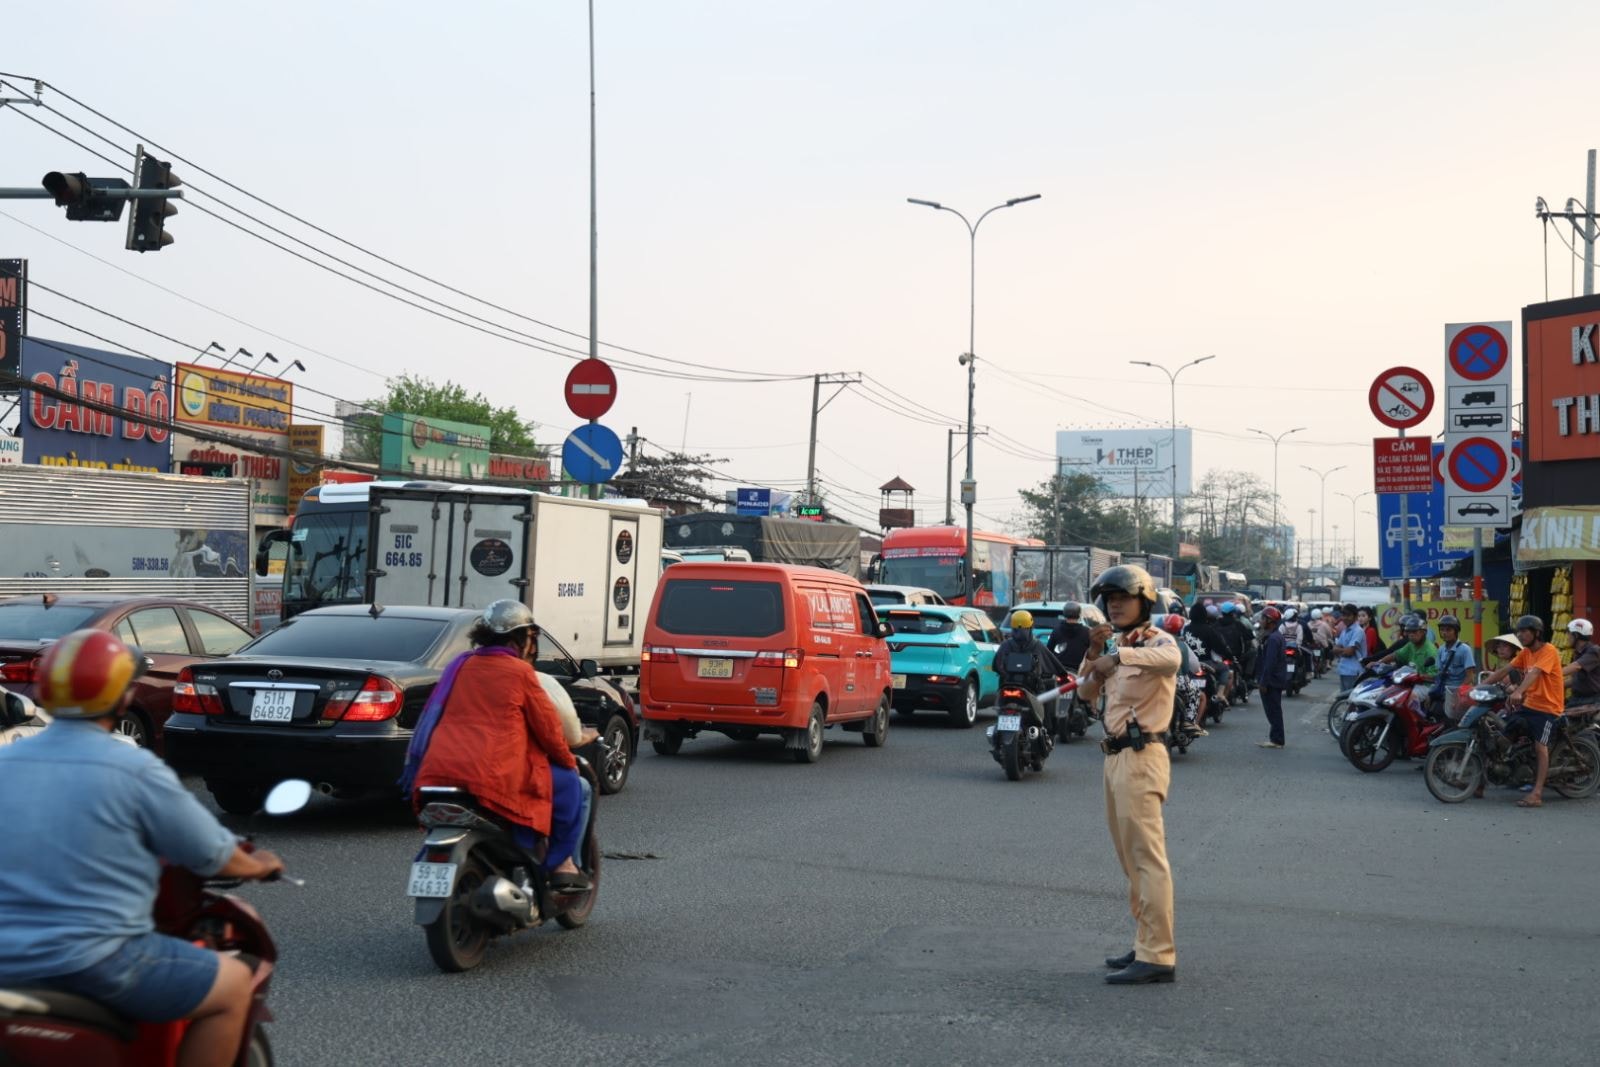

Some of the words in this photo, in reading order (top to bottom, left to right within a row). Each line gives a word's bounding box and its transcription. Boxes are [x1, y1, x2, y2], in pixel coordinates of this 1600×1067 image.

[1572, 322, 1600, 365] K
[1117, 446, 1153, 458] THÉP
[1391, 439, 1416, 452] CẤM
[394, 534, 412, 549] 51C
[386, 552, 422, 567] 664.85
[264, 691, 285, 704] 51H
[254, 706, 290, 721] 648.92
